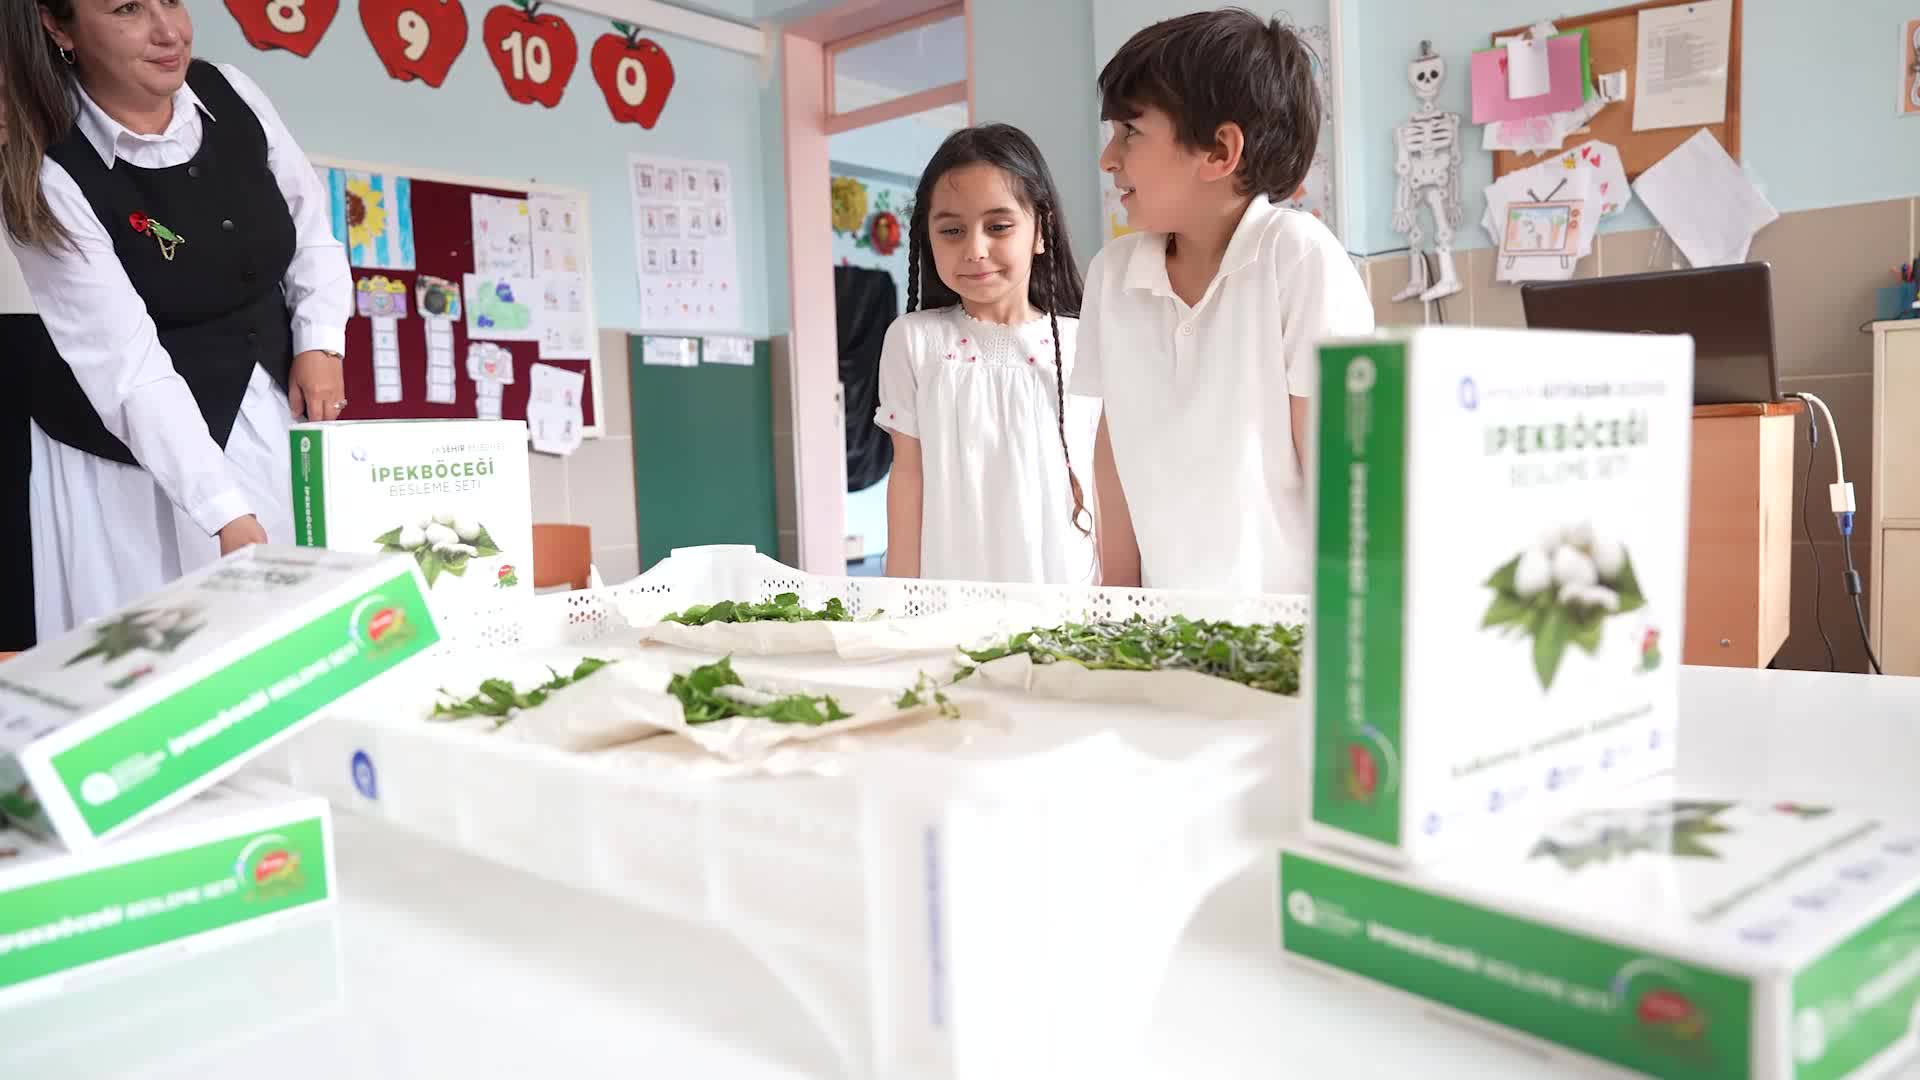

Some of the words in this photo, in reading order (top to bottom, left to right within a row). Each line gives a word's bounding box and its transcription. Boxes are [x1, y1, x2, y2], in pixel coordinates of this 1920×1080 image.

[266, 0, 307, 34] 8
[397, 10, 430, 62] 9
[501, 31, 552, 84] 10
[616, 56, 648, 106] 0
[371, 457, 494, 483] İPEKBÖCEĞİ
[389, 481, 449, 497] BESLEME
